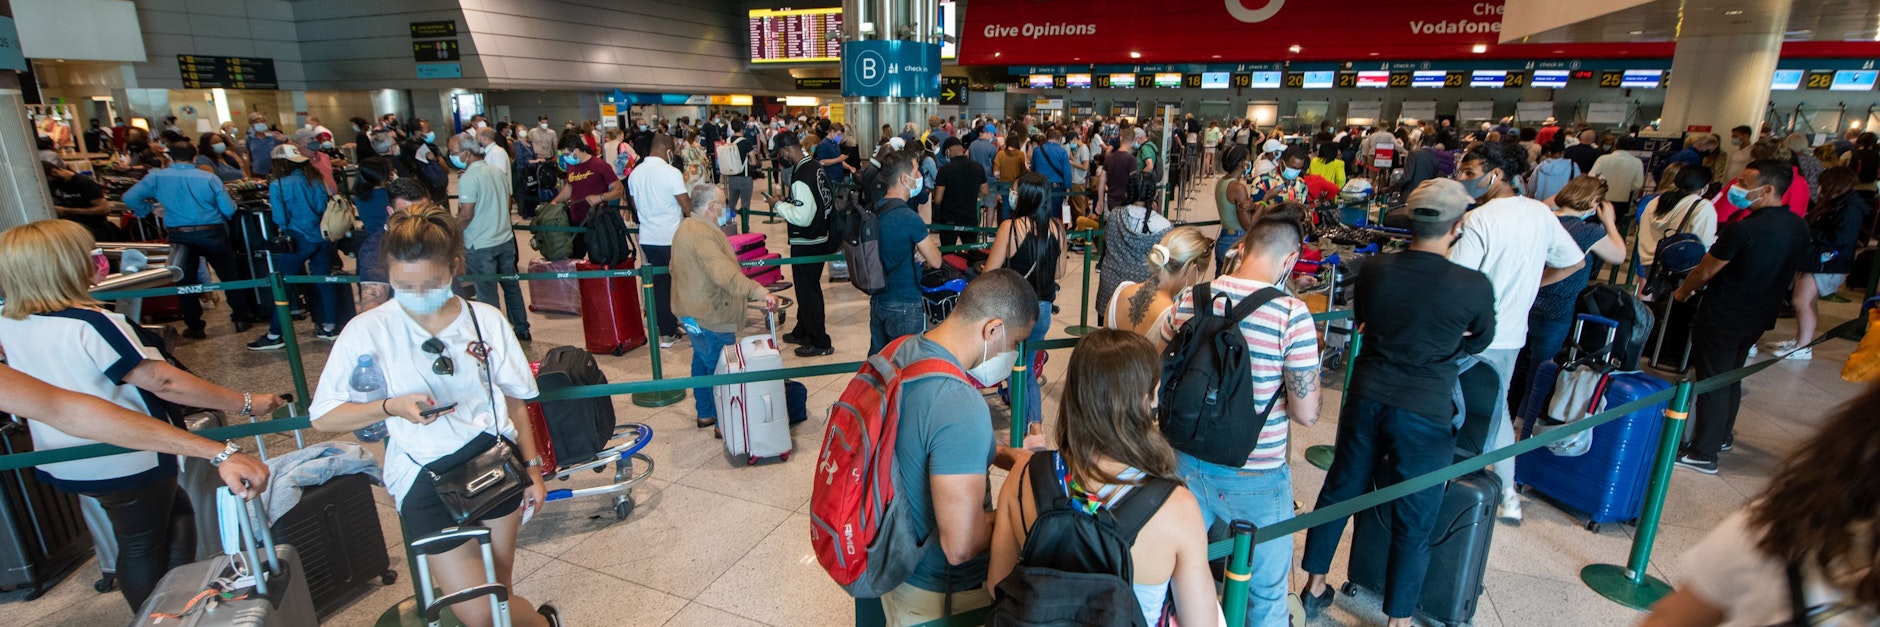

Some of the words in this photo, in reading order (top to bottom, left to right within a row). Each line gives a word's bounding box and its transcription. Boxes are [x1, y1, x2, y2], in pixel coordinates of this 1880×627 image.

[984, 24, 1018, 38] Give
[1022, 23, 1096, 39] Opinions
[1410, 20, 1501, 34] Vodafone
[863, 58, 876, 79] B
[1020, 78, 1030, 87] 14
[1054, 77, 1065, 86] 15
[1098, 77, 1109, 87] 16
[1140, 76, 1152, 86] 17
[1188, 76, 1201, 86] 18
[1235, 76, 1248, 86] 19
[1288, 76, 1302, 86] 20
[1340, 75, 1355, 86] 21
[1391, 75, 1408, 86] 22
[1445, 75, 1462, 86] 23
[1505, 74, 1523, 86] 24
[1601, 74, 1621, 86] 25
[1808, 74, 1831, 87] 28
